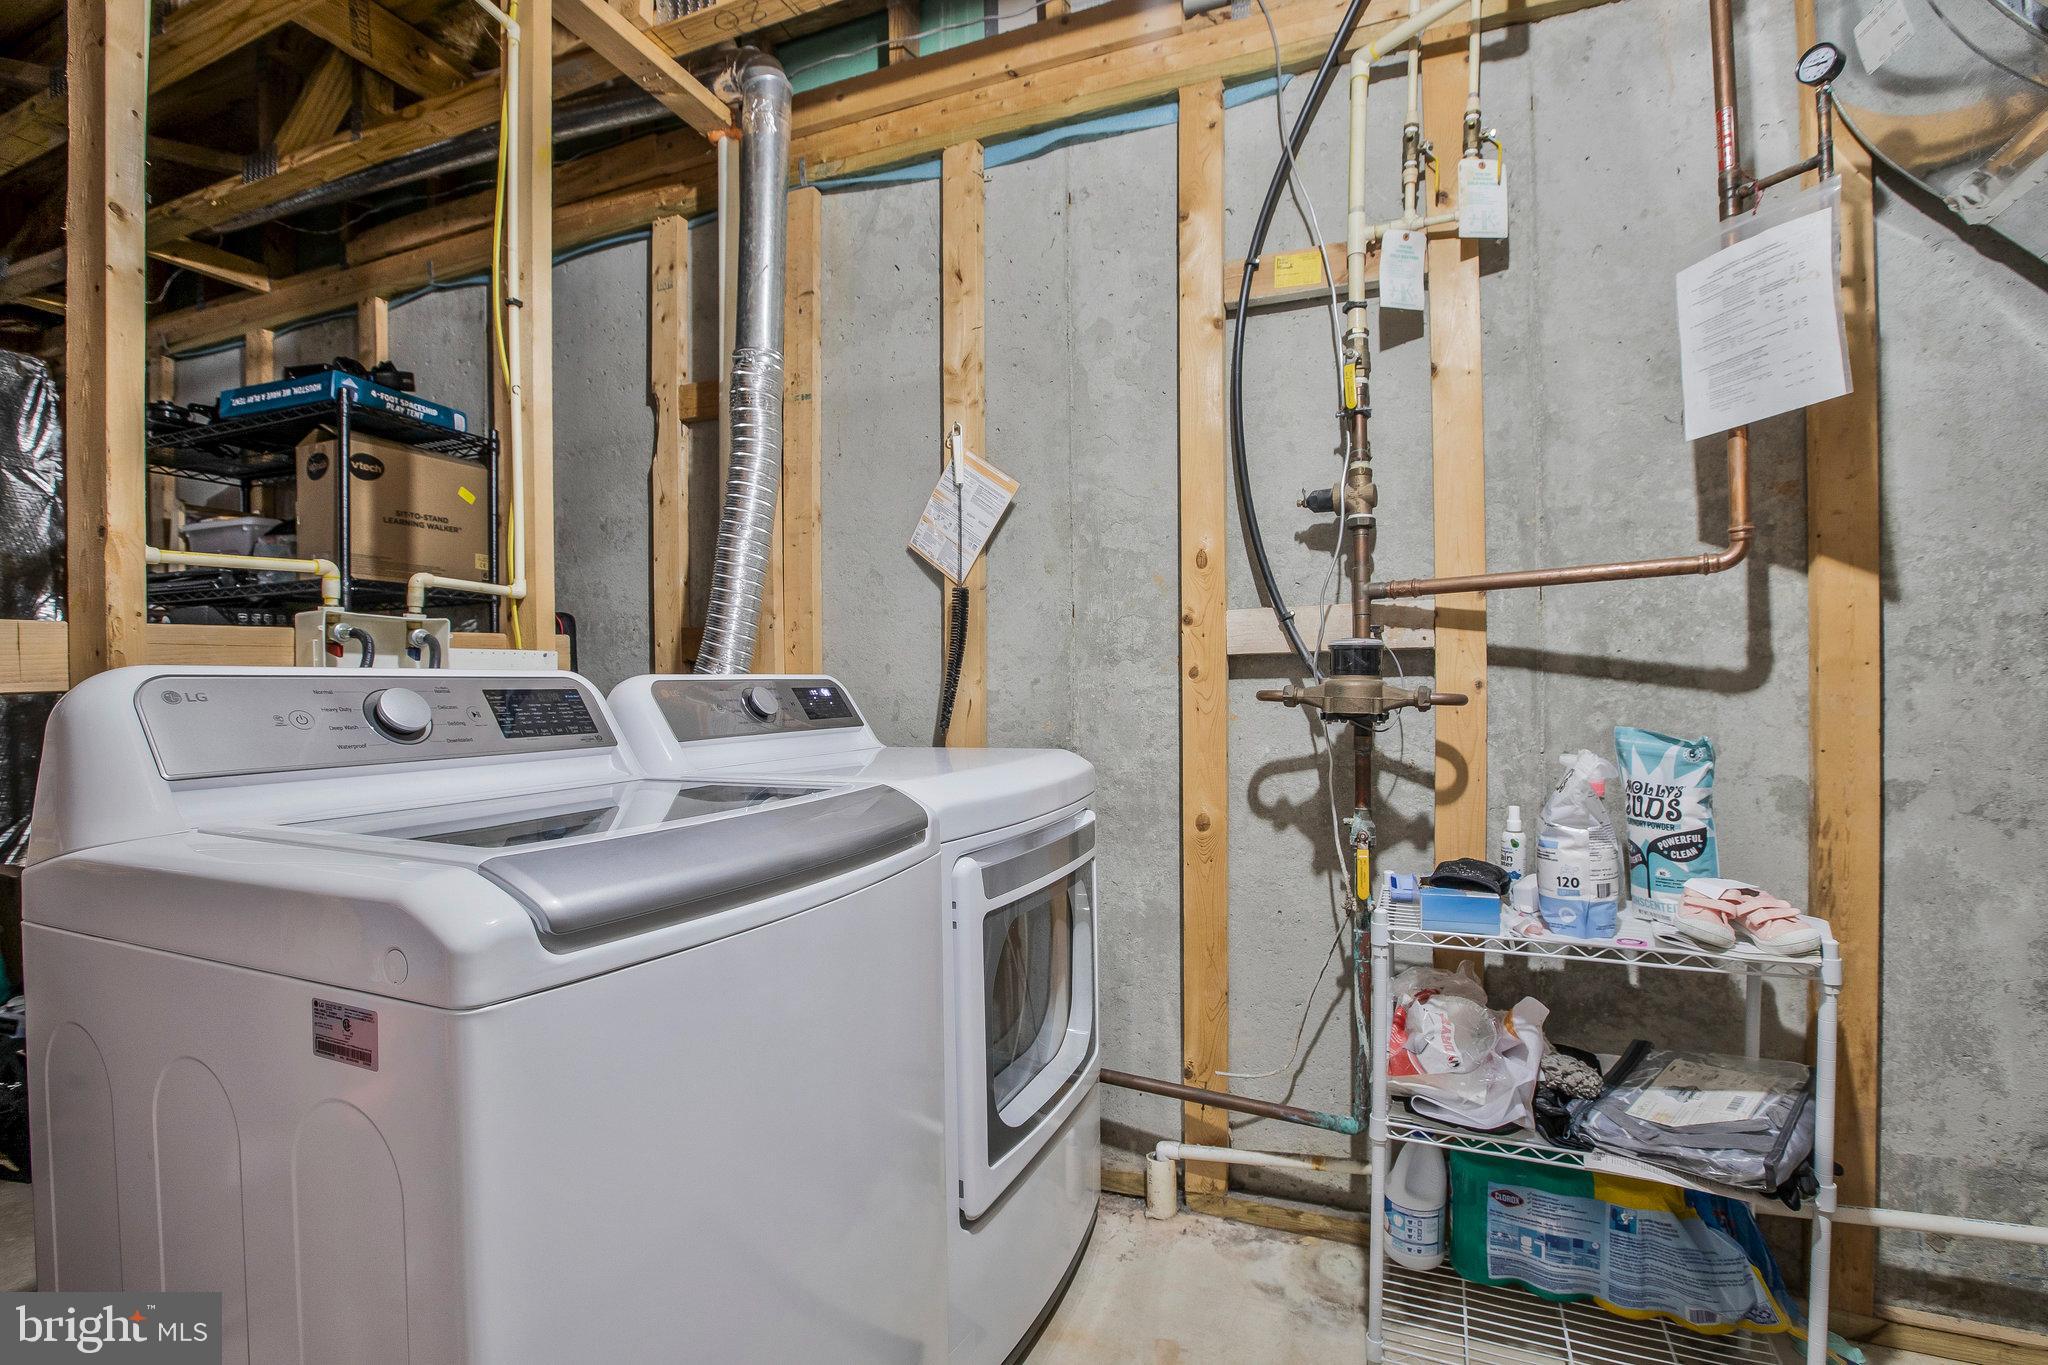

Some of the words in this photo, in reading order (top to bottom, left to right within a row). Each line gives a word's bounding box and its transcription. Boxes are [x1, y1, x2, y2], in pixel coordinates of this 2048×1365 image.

[370, 389, 399, 404] 4-FOOT
[399, 398, 439, 417] SPACESHIP
[385, 402, 405, 414] PLAY
[406, 408, 424, 420] TENT
[383, 516, 425, 529] LEARNING
[395, 510, 449, 524] SIT-TO-STAND
[184, 692, 208, 702] LG
[1646, 822, 1675, 831] POWDER
[1656, 834, 1704, 851] POWERFUL
[1670, 846, 1699, 859] CLEAN
[1556, 875, 1580, 889] 120
[1494, 1192, 1520, 1205] CLOROX
